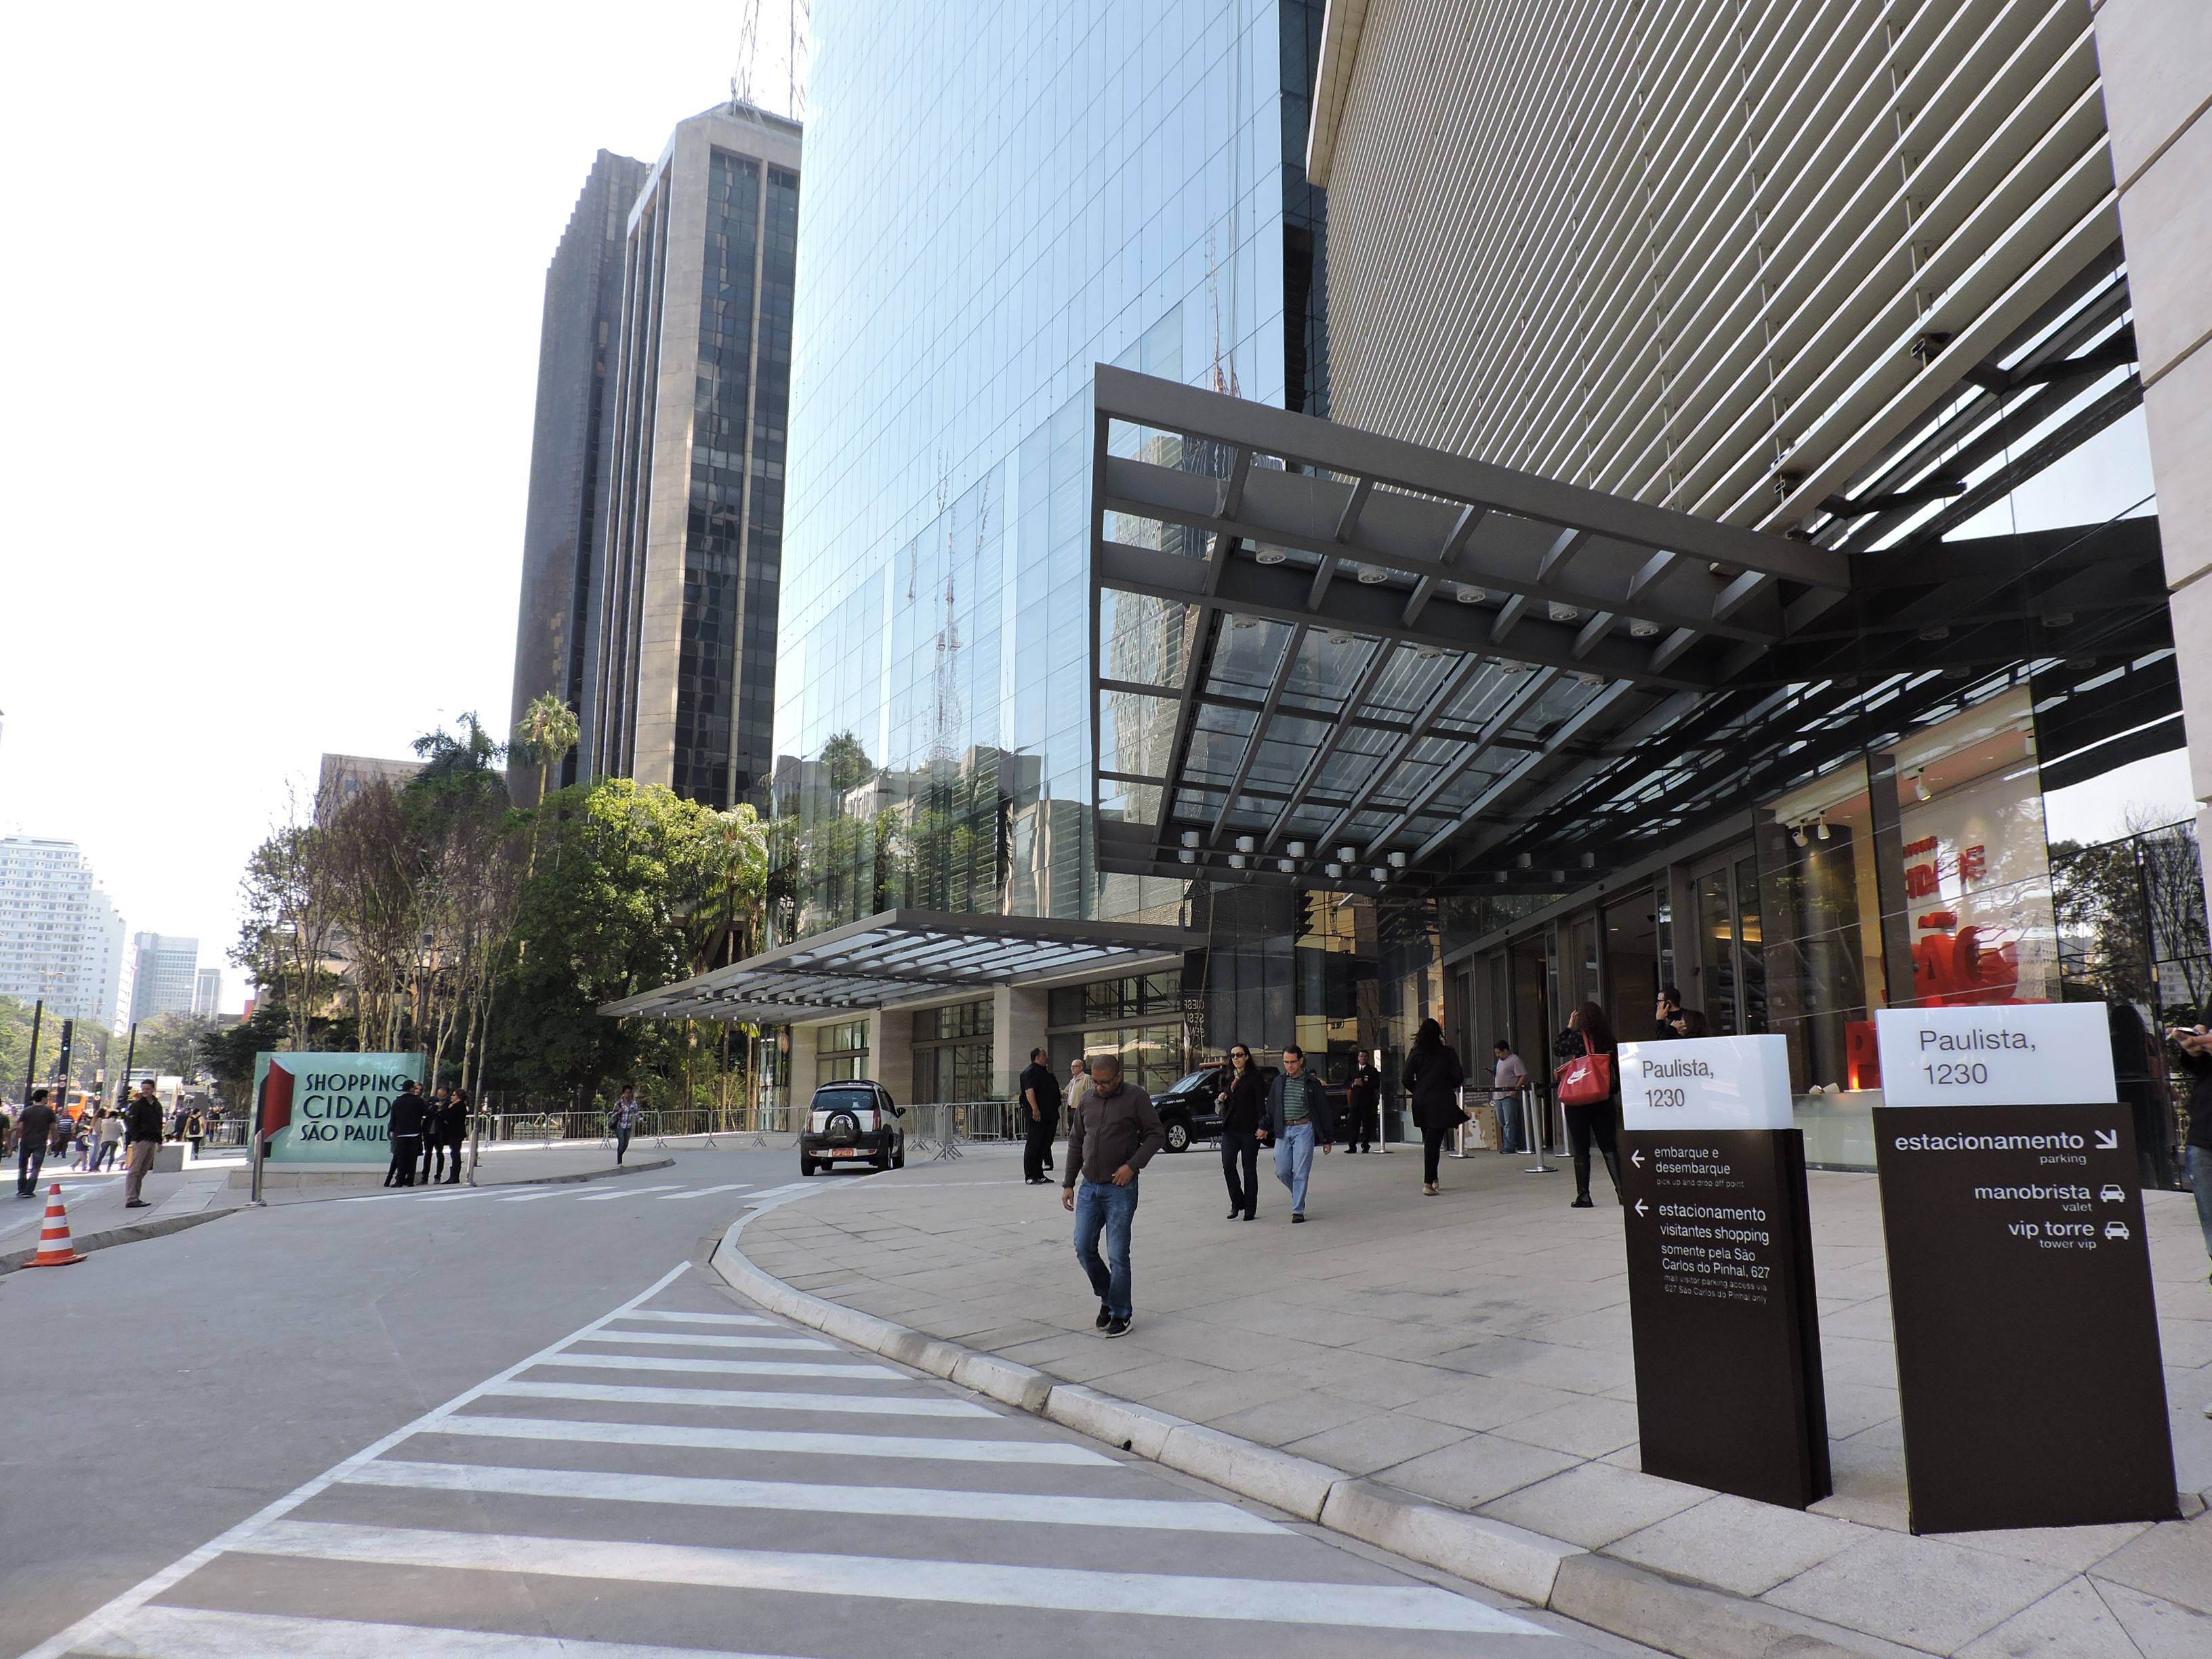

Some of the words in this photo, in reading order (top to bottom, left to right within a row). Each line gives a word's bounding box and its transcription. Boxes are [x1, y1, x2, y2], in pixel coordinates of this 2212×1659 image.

[1919, 1029, 2036, 1052] Paulista,
[1642, 1058, 1715, 1079] Paulista,
[1923, 1063, 1988, 1085] 1230
[304, 1073, 408, 1092] SHOPPING
[1645, 1088, 1685, 1107] 1230
[303, 1095, 392, 1119] CIDAD
[300, 1120, 338, 1141] SÃO
[344, 1124, 392, 1141] PAUL
[1895, 1132, 2085, 1150] estacionamento
[1654, 1147, 1709, 1161] embarque
[1712, 1149, 1719, 1159] e
[2040, 1154, 2087, 1166] parking
[1656, 1162, 1731, 1176] desembarque
[1974, 1184, 2091, 1200] manobrista
[1659, 1204, 1766, 1221] estacionamento
[2062, 1202, 2093, 1212] valet
[1660, 1223, 1713, 1238] visitantes
[1715, 1227, 1770, 1246] shopping
[2008, 1221, 2040, 1240] vip
[2045, 1221, 2095, 1236] torre
[1661, 1245, 1706, 1257] somente
[1708, 1247, 1732, 1260] pela
[1734, 1248, 1756, 1262] São
[2039, 1239, 2074, 1249] tower
[2077, 1240, 2097, 1251] vip
[1662, 1258, 1695, 1272] Carlos
[1697, 1261, 1711, 1273] do
[1713, 1262, 1748, 1278] Pinhal,
[1750, 1266, 1770, 1279] 627
[1702, 1277, 1728, 1288] parking
[1729, 1281, 1755, 1290] access
[1717, 1290, 1727, 1298] do
